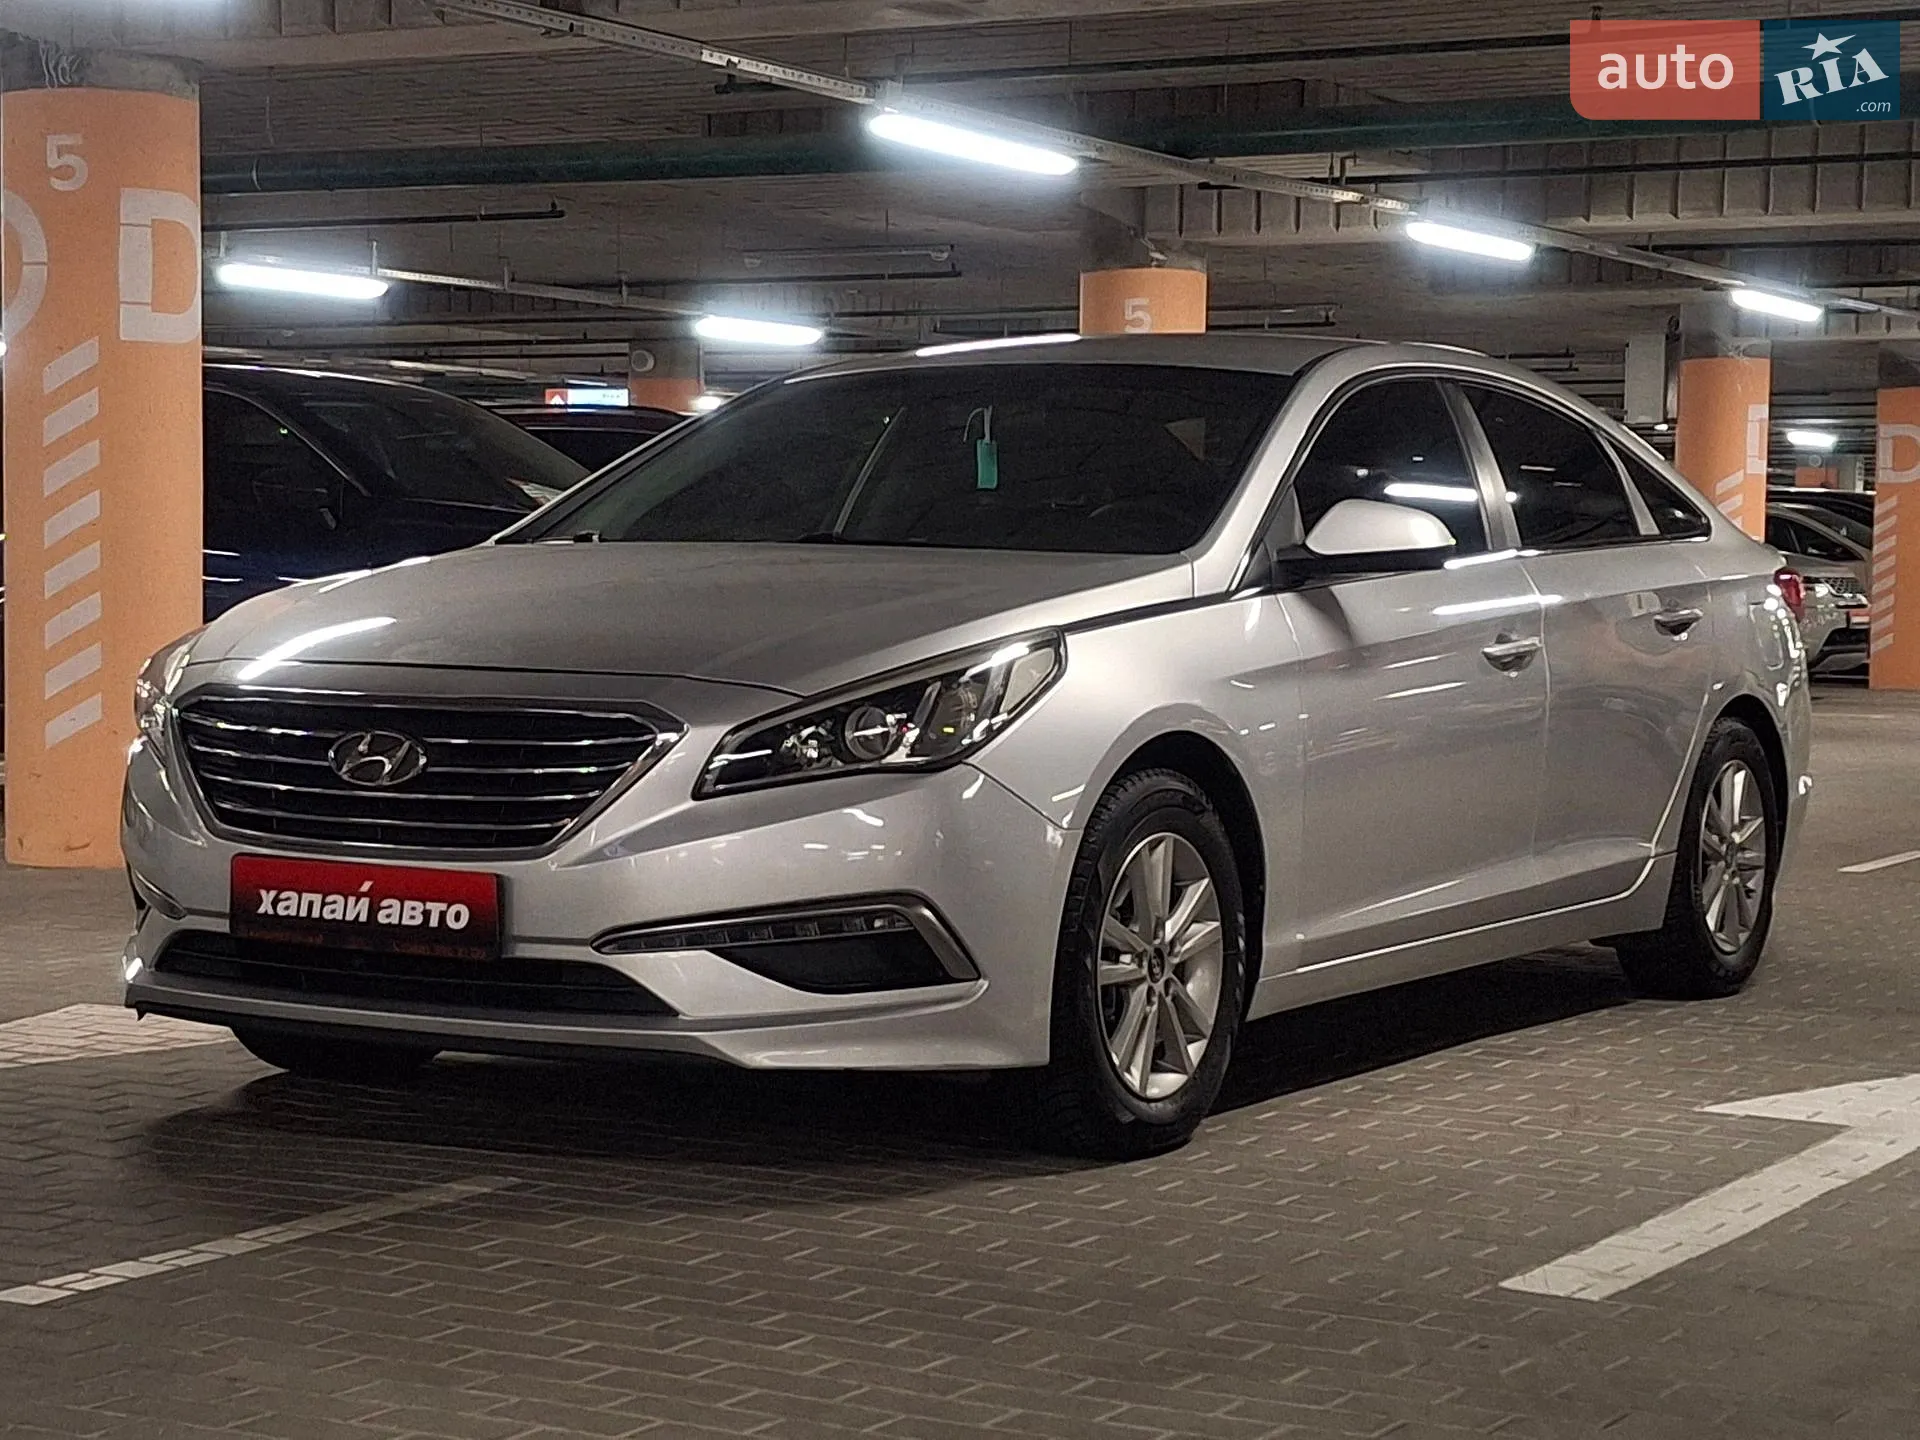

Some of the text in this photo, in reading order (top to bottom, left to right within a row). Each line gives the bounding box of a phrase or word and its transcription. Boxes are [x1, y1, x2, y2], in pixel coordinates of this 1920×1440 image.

[46, 133, 89, 191] 5
[119, 187, 201, 343] D
[1124, 297, 1154, 333] 5
[376, 897, 470, 931] авто
